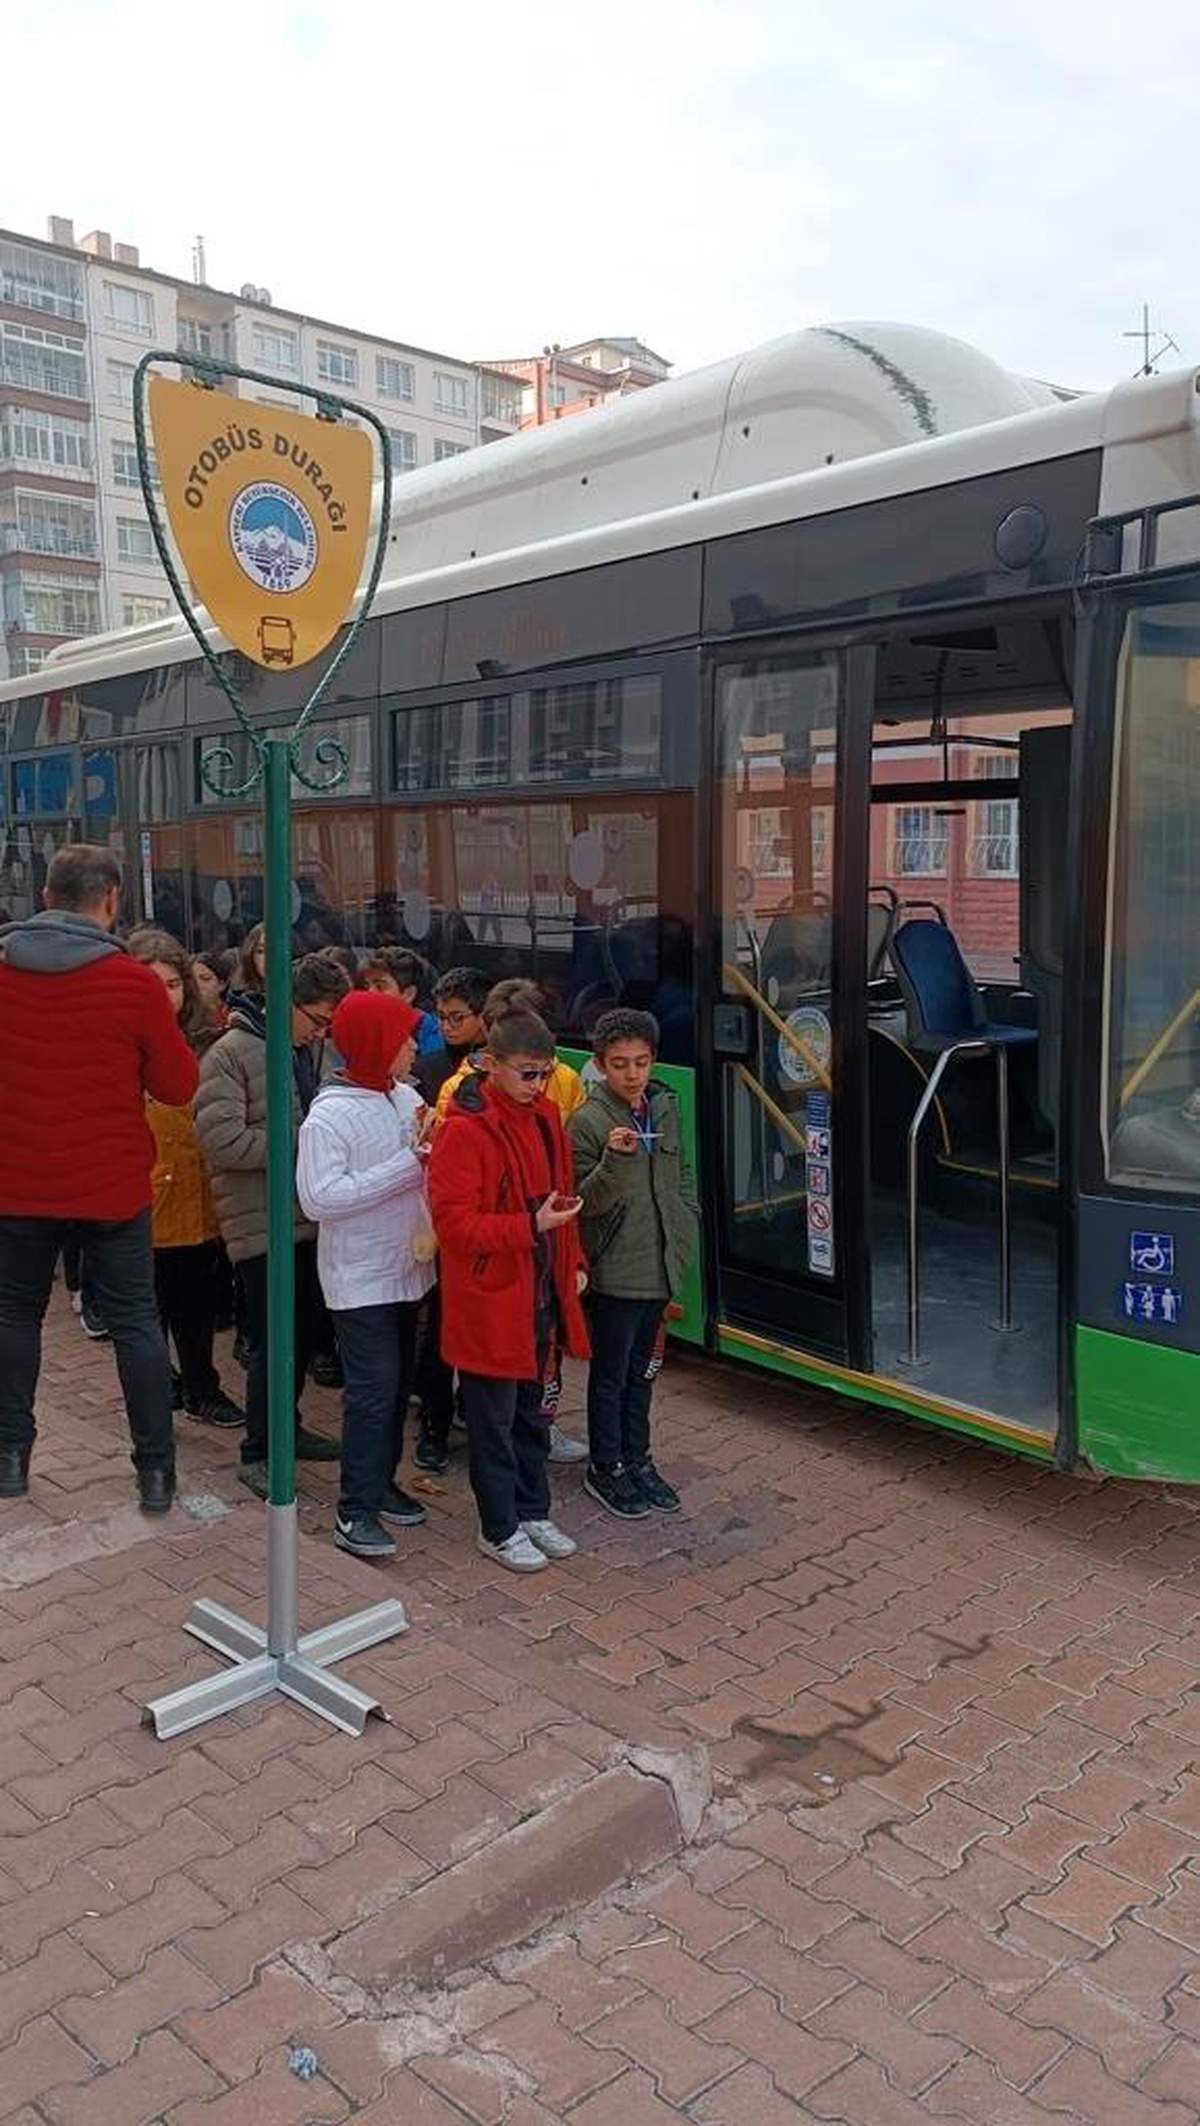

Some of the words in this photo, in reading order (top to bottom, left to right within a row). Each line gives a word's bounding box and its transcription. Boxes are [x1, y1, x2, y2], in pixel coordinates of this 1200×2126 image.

[184, 423, 264, 509] OTOBÜS
[272, 433, 347, 532] DURAĞI
[262, 575, 291, 590] 1869
